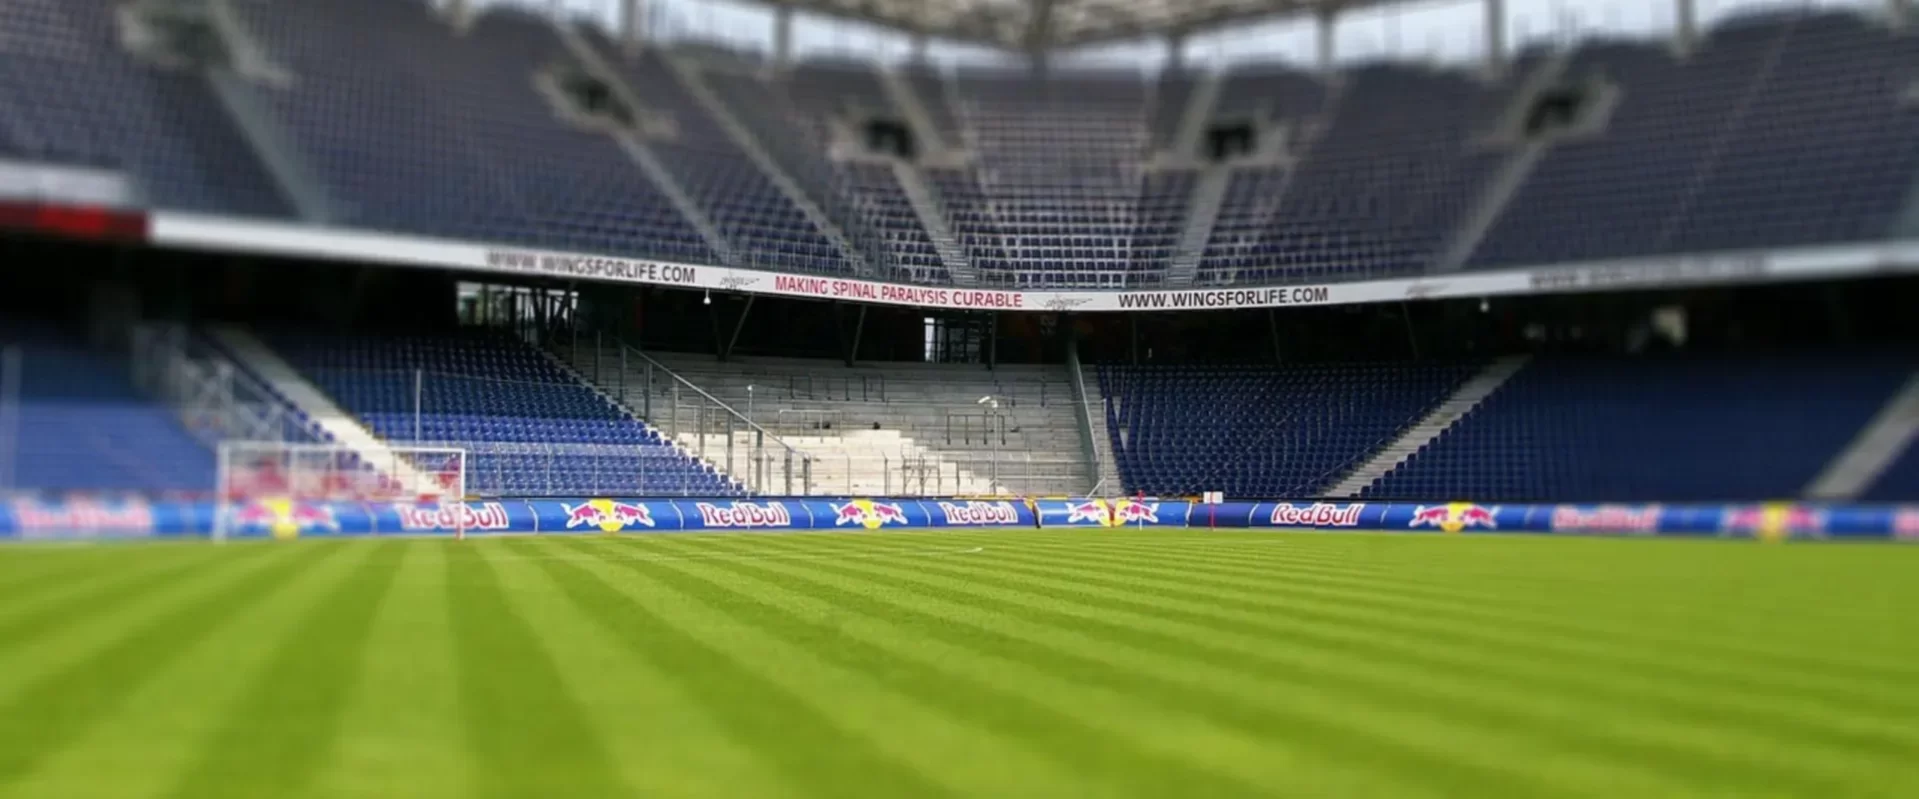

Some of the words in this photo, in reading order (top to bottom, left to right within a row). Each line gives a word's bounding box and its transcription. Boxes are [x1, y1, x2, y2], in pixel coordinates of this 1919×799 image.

[487, 249, 696, 284] INGSFORLIFE.COM
[775, 275, 828, 296] MAKING
[832, 281, 877, 300] SPINAL
[881, 287, 948, 305] PARALYSIS
[953, 291, 1023, 308] CURABLE
[1118, 287, 1329, 308] WWW.WINGSFORLIFE.COM
